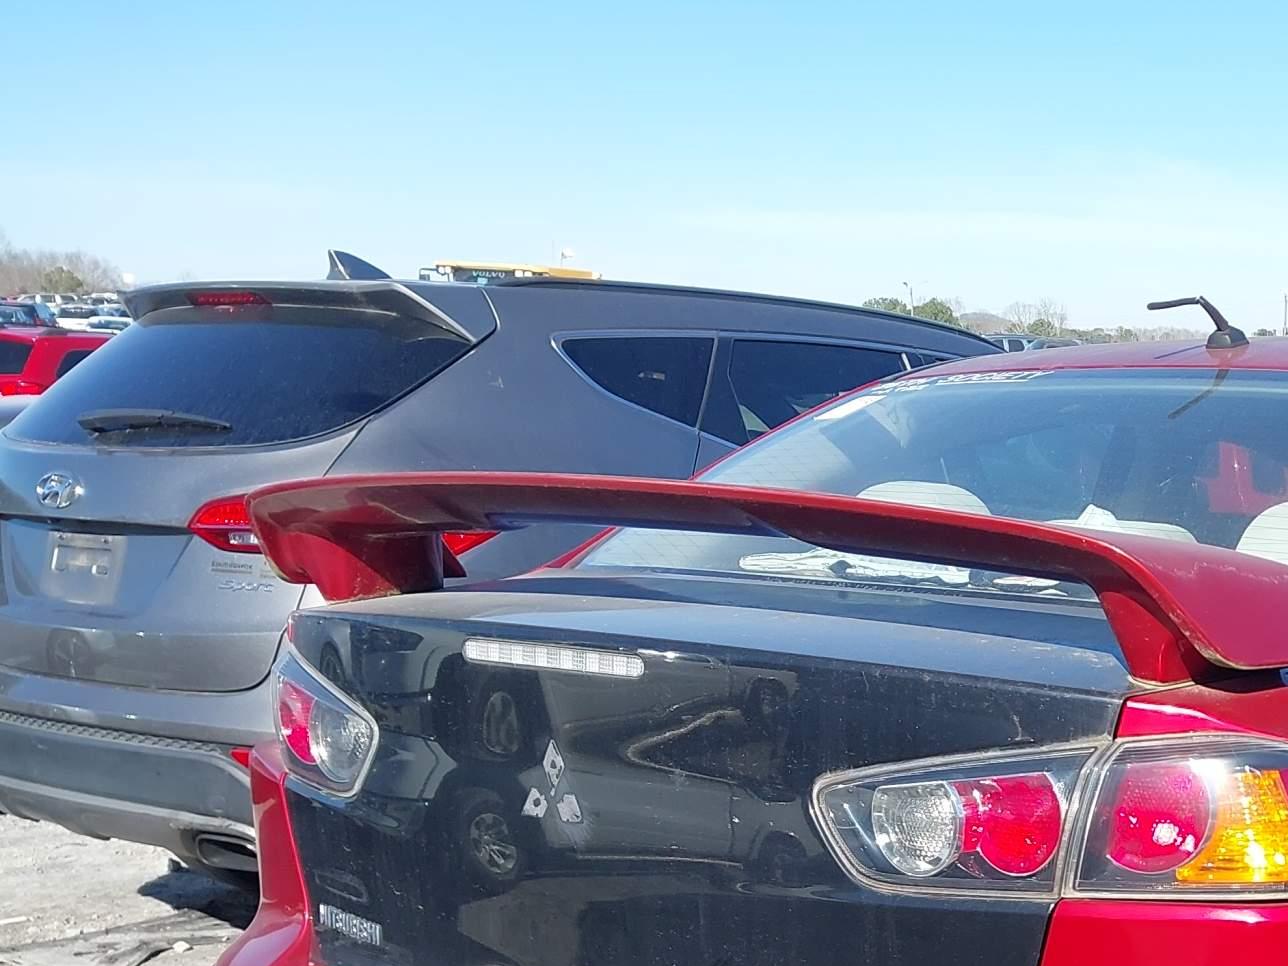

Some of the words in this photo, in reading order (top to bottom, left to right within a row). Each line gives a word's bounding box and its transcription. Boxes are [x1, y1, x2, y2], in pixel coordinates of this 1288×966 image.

[472, 269, 506, 279] VOLVO
[218, 580, 274, 592] Sport
[319, 903, 382, 946] MITSUBISHI
